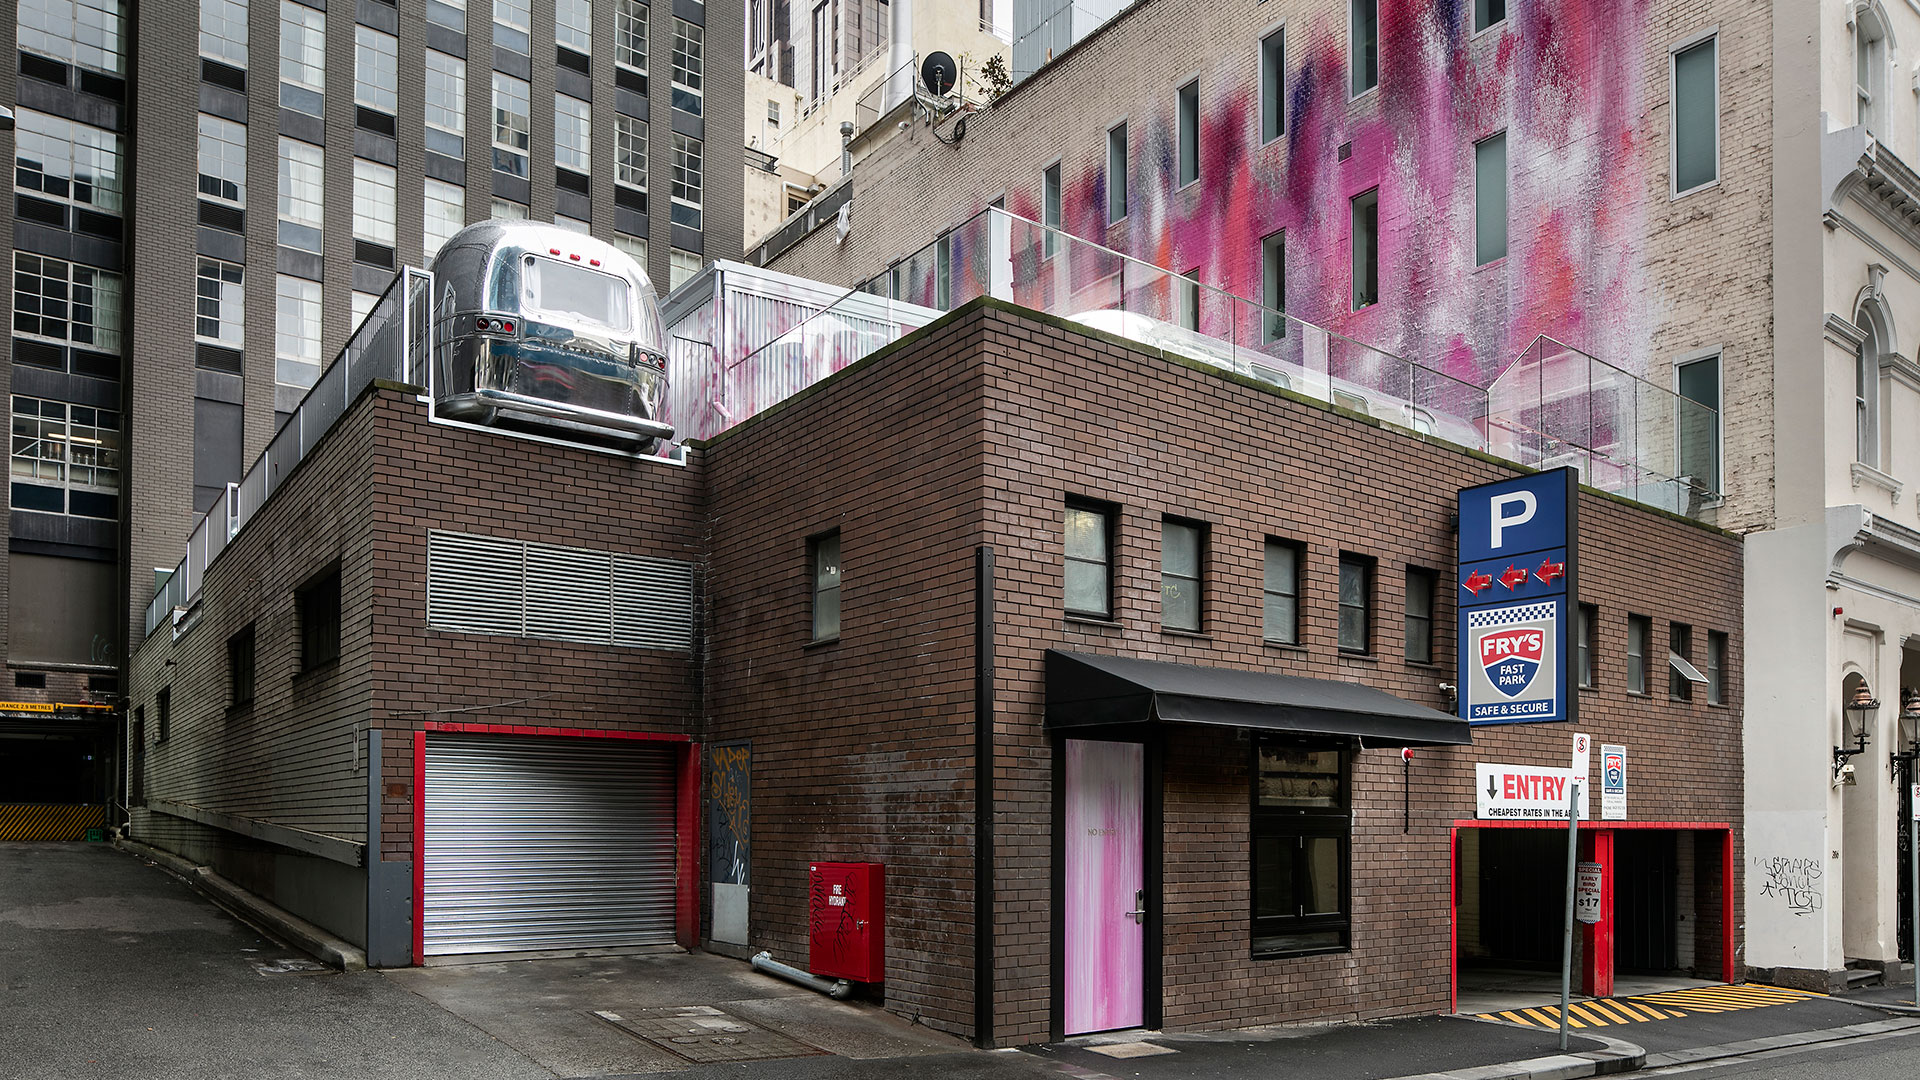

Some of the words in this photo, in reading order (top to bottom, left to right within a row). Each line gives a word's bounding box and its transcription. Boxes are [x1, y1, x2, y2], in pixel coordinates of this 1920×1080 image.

[1490, 490, 1537, 549] P
[1482, 633, 1541, 656] FRY'S
[1500, 664, 1525, 675] FAST
[1499, 674, 1526, 686] PARK
[1475, 705, 1499, 716] SAFE
[1500, 704, 1508, 714] &
[1509, 702, 1549, 713] SECURE
[1503, 774, 1567, 801] ENTRY
[1488, 807, 1522, 817] CHEAPEST
[1523, 808, 1543, 817] RATES
[1544, 809, 1551, 817] IN
[1552, 809, 1563, 818] THE
[1087, 828, 1098, 837] NO
[832, 884, 842, 895] FIRE
[1578, 898, 1600, 908] $17
